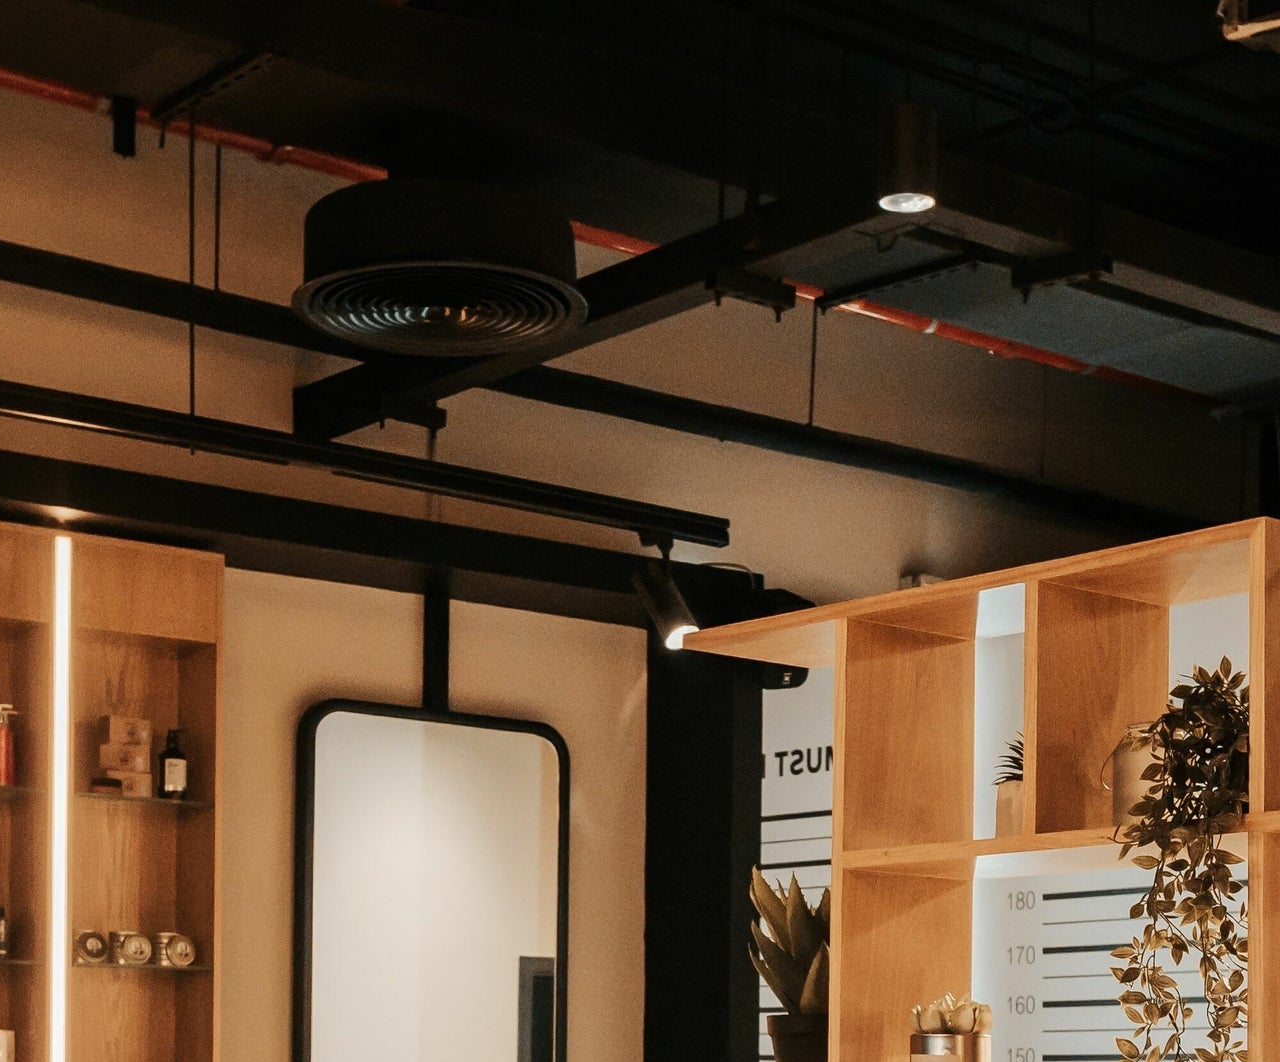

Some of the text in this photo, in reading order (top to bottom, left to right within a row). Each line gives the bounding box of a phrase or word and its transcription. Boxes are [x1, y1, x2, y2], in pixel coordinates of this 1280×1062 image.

[1007, 890, 1036, 911] 180
[1007, 945, 1036, 965] 170
[1007, 994, 1036, 1015] 160
